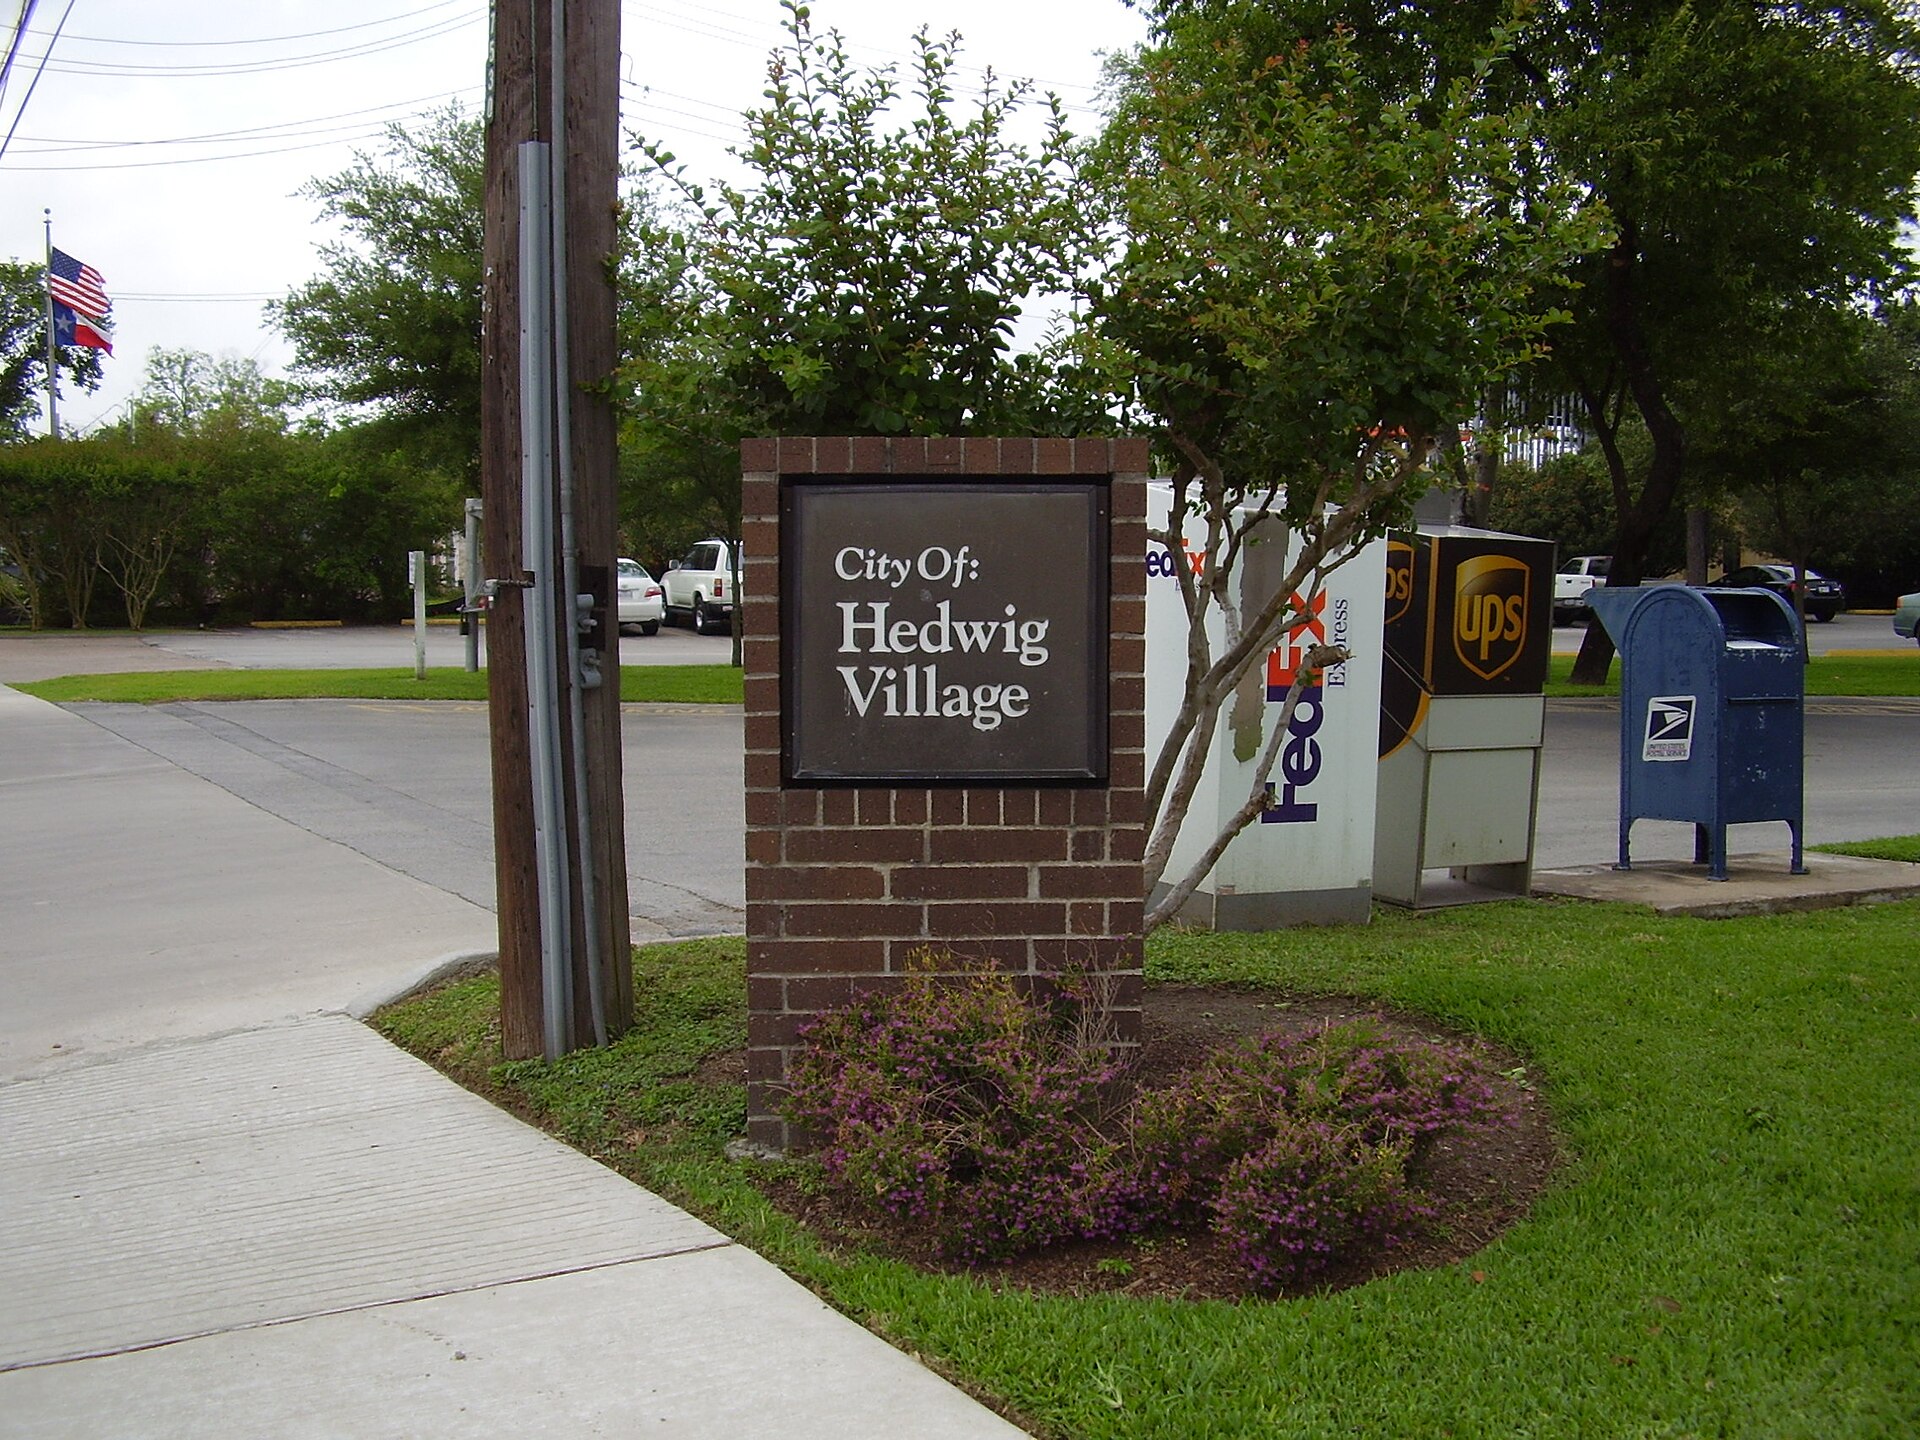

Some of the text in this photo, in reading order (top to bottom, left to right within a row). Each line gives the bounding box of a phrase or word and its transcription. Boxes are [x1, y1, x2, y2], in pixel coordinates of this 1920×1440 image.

[835, 546, 980, 588] City Of:
[836, 600, 1049, 666] Hedwig
[836, 664, 1030, 731] Village
